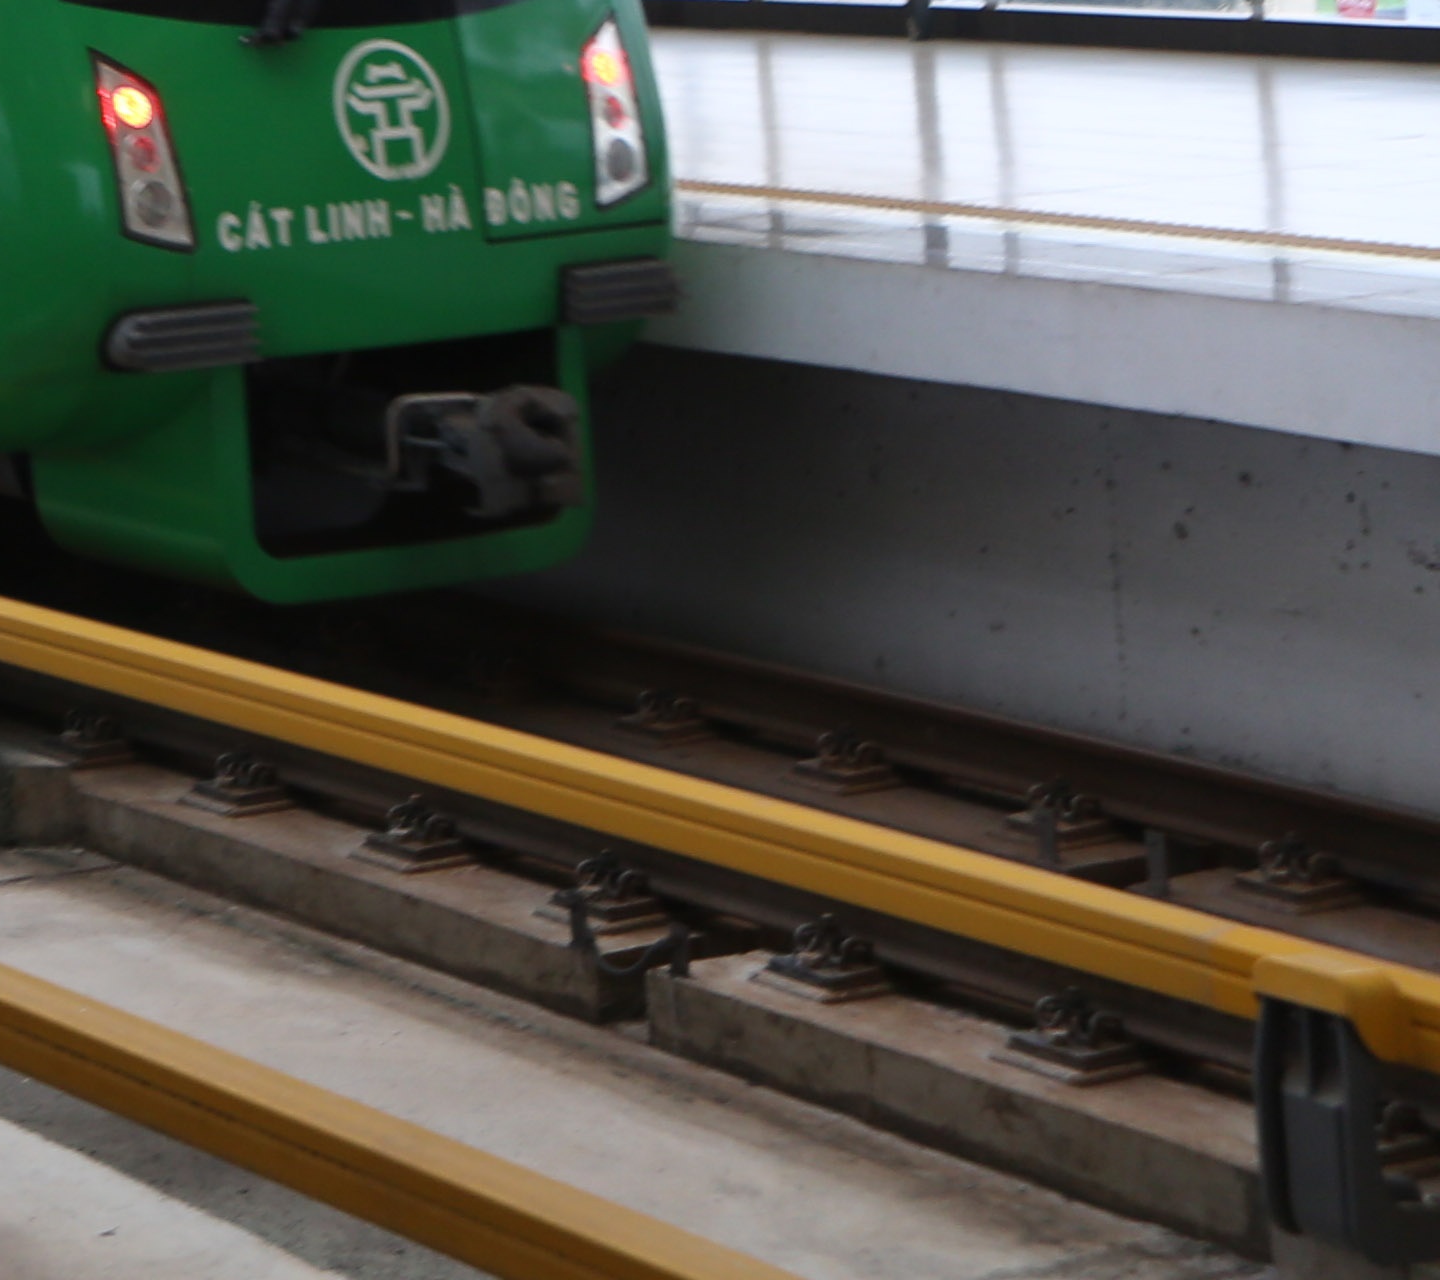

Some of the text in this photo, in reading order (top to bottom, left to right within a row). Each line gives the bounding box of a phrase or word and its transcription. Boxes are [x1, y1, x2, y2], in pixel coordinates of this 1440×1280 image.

[216, 200, 294, 252] CÁT
[304, 198, 391, 244] LINH
[419, 182, 473, 234] HÀ
